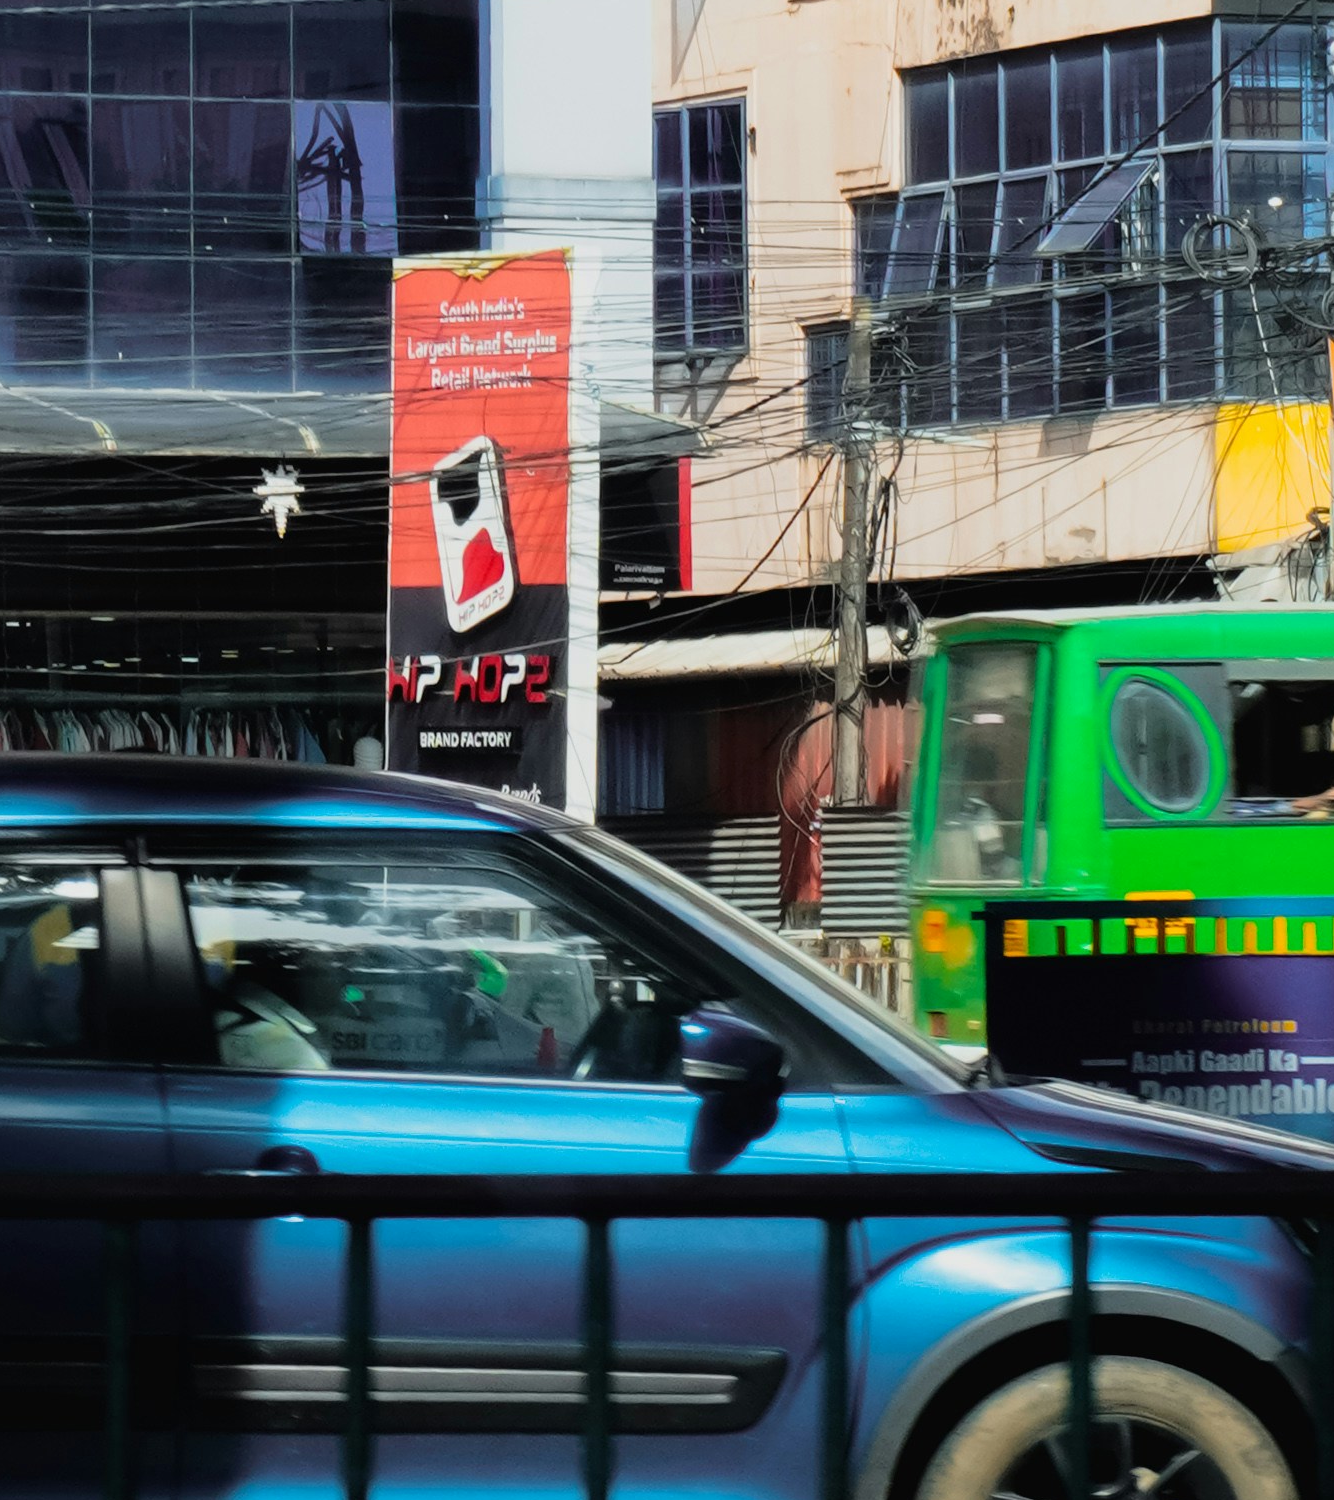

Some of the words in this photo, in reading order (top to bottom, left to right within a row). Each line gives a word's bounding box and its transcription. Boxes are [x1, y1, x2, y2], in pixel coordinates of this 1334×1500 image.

[439, 299, 480, 323] South
[481, 296, 526, 322] India's
[406, 335, 458, 364] Largest
[459, 331, 502, 355] Brand
[503, 328, 558, 360] Surplus
[430, 366, 471, 391] Retail
[472, 363, 533, 390] Network
[387, 654, 442, 704] HIP
[419, 731, 460, 749] BRAND
[460, 731, 513, 748] FACTORY
[1131, 1049, 1196, 1075] Aapki
[1198, 1047, 1266, 1074] Gaadi
[1267, 1047, 1299, 1073] Ka
